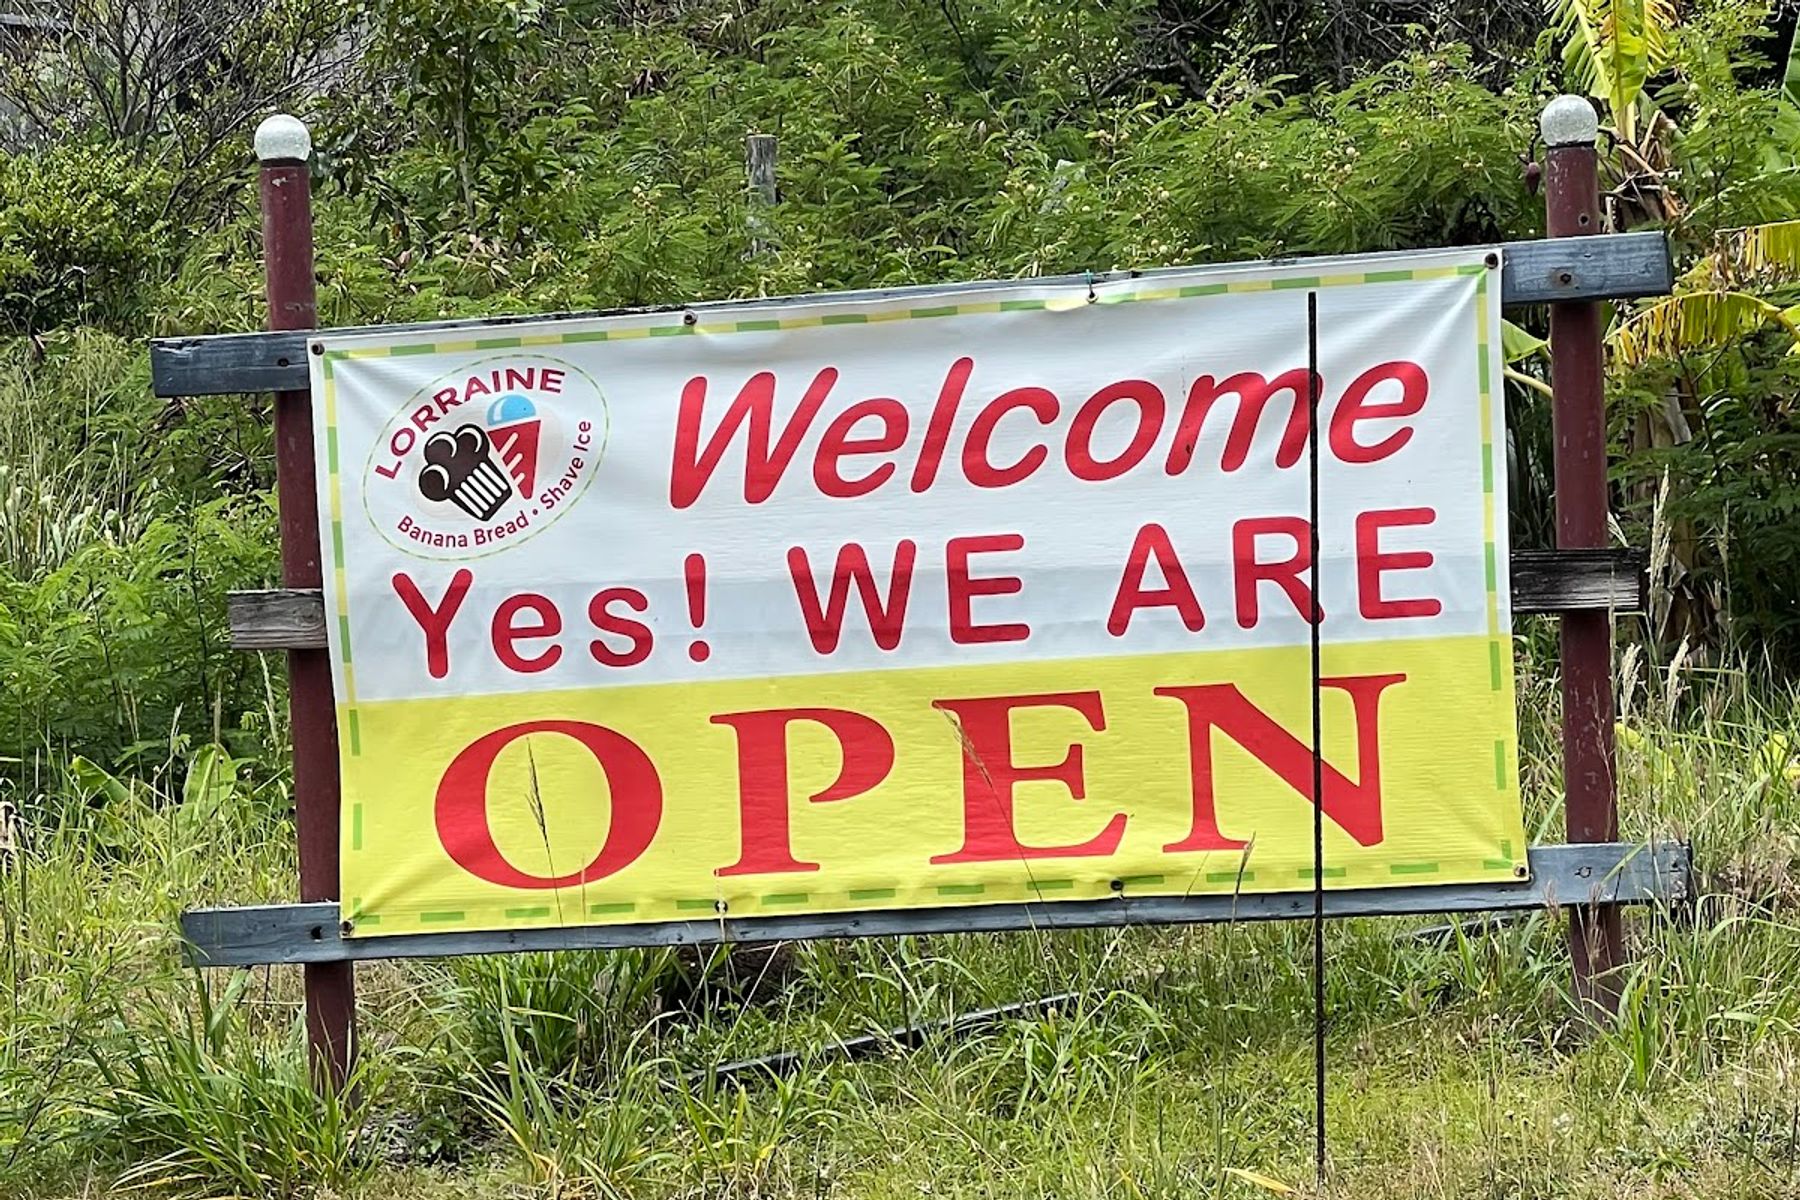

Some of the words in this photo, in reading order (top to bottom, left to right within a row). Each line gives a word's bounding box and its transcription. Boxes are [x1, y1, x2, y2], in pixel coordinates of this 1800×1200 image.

[374, 367, 566, 480] LORRAINE
[397, 515, 468, 548] Banana
[474, 511, 529, 545] Bread
[540, 456, 584, 510] Shave
[573, 420, 592, 453] Ice
[669, 356, 1430, 509] Welcome
[391, 552, 710, 679] Yes!
[786, 533, 1031, 656] WE
[1106, 506, 1442, 638] ARE
[434, 672, 1407, 890] OPEN
